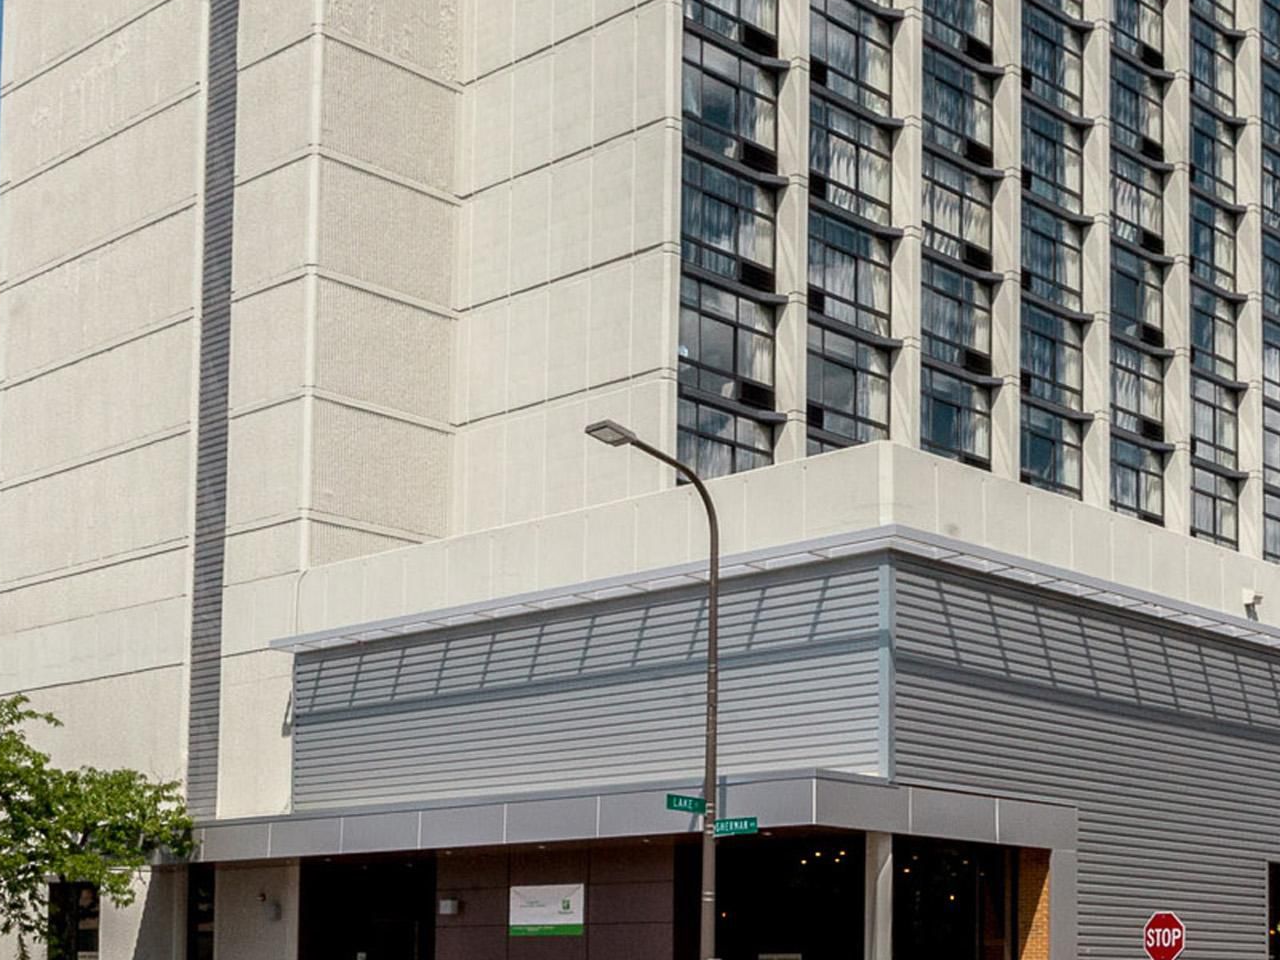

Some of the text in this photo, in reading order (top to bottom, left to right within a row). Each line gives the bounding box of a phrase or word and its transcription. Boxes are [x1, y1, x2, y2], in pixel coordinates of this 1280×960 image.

[673, 797, 694, 809] LAKE
[716, 820, 748, 833] SHERMAN
[1146, 927, 1182, 948] STOP
